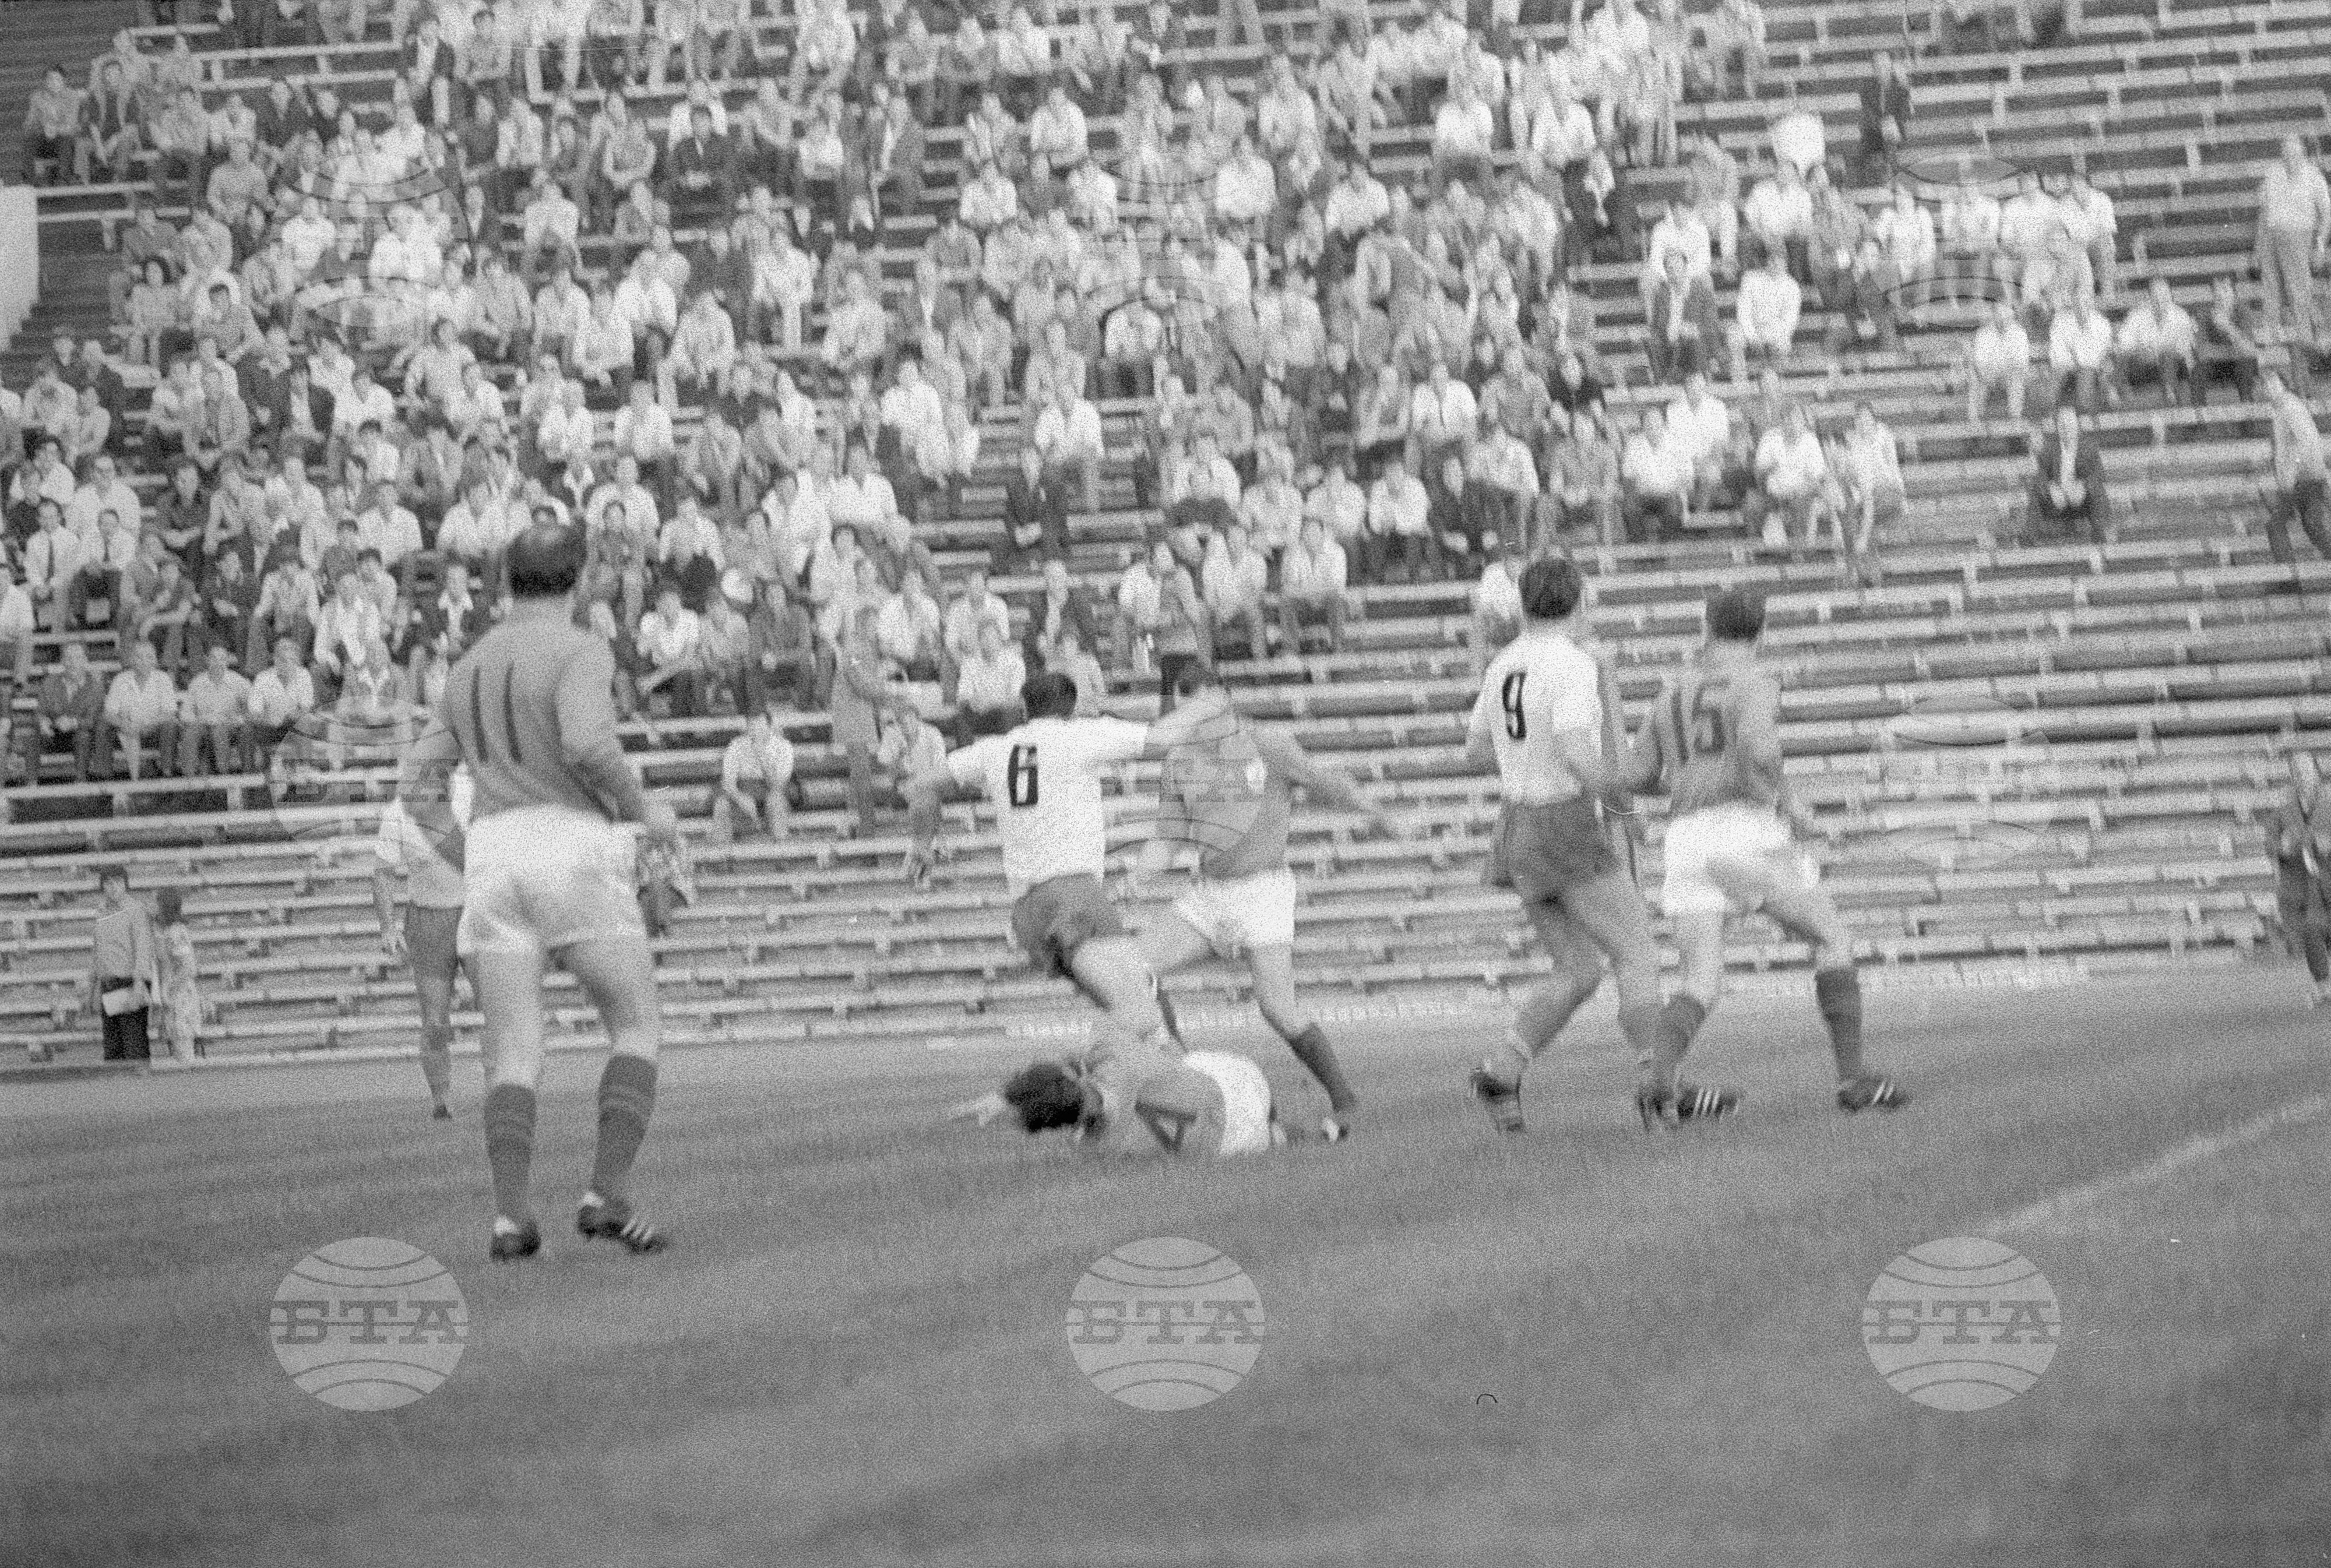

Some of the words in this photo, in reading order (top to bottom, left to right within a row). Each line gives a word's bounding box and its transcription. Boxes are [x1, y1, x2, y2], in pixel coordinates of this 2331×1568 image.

[470, 663, 522, 763] 11
[1502, 670, 1526, 741] 9
[1670, 677, 1730, 763] 15
[1008, 744, 1038, 808] 6
